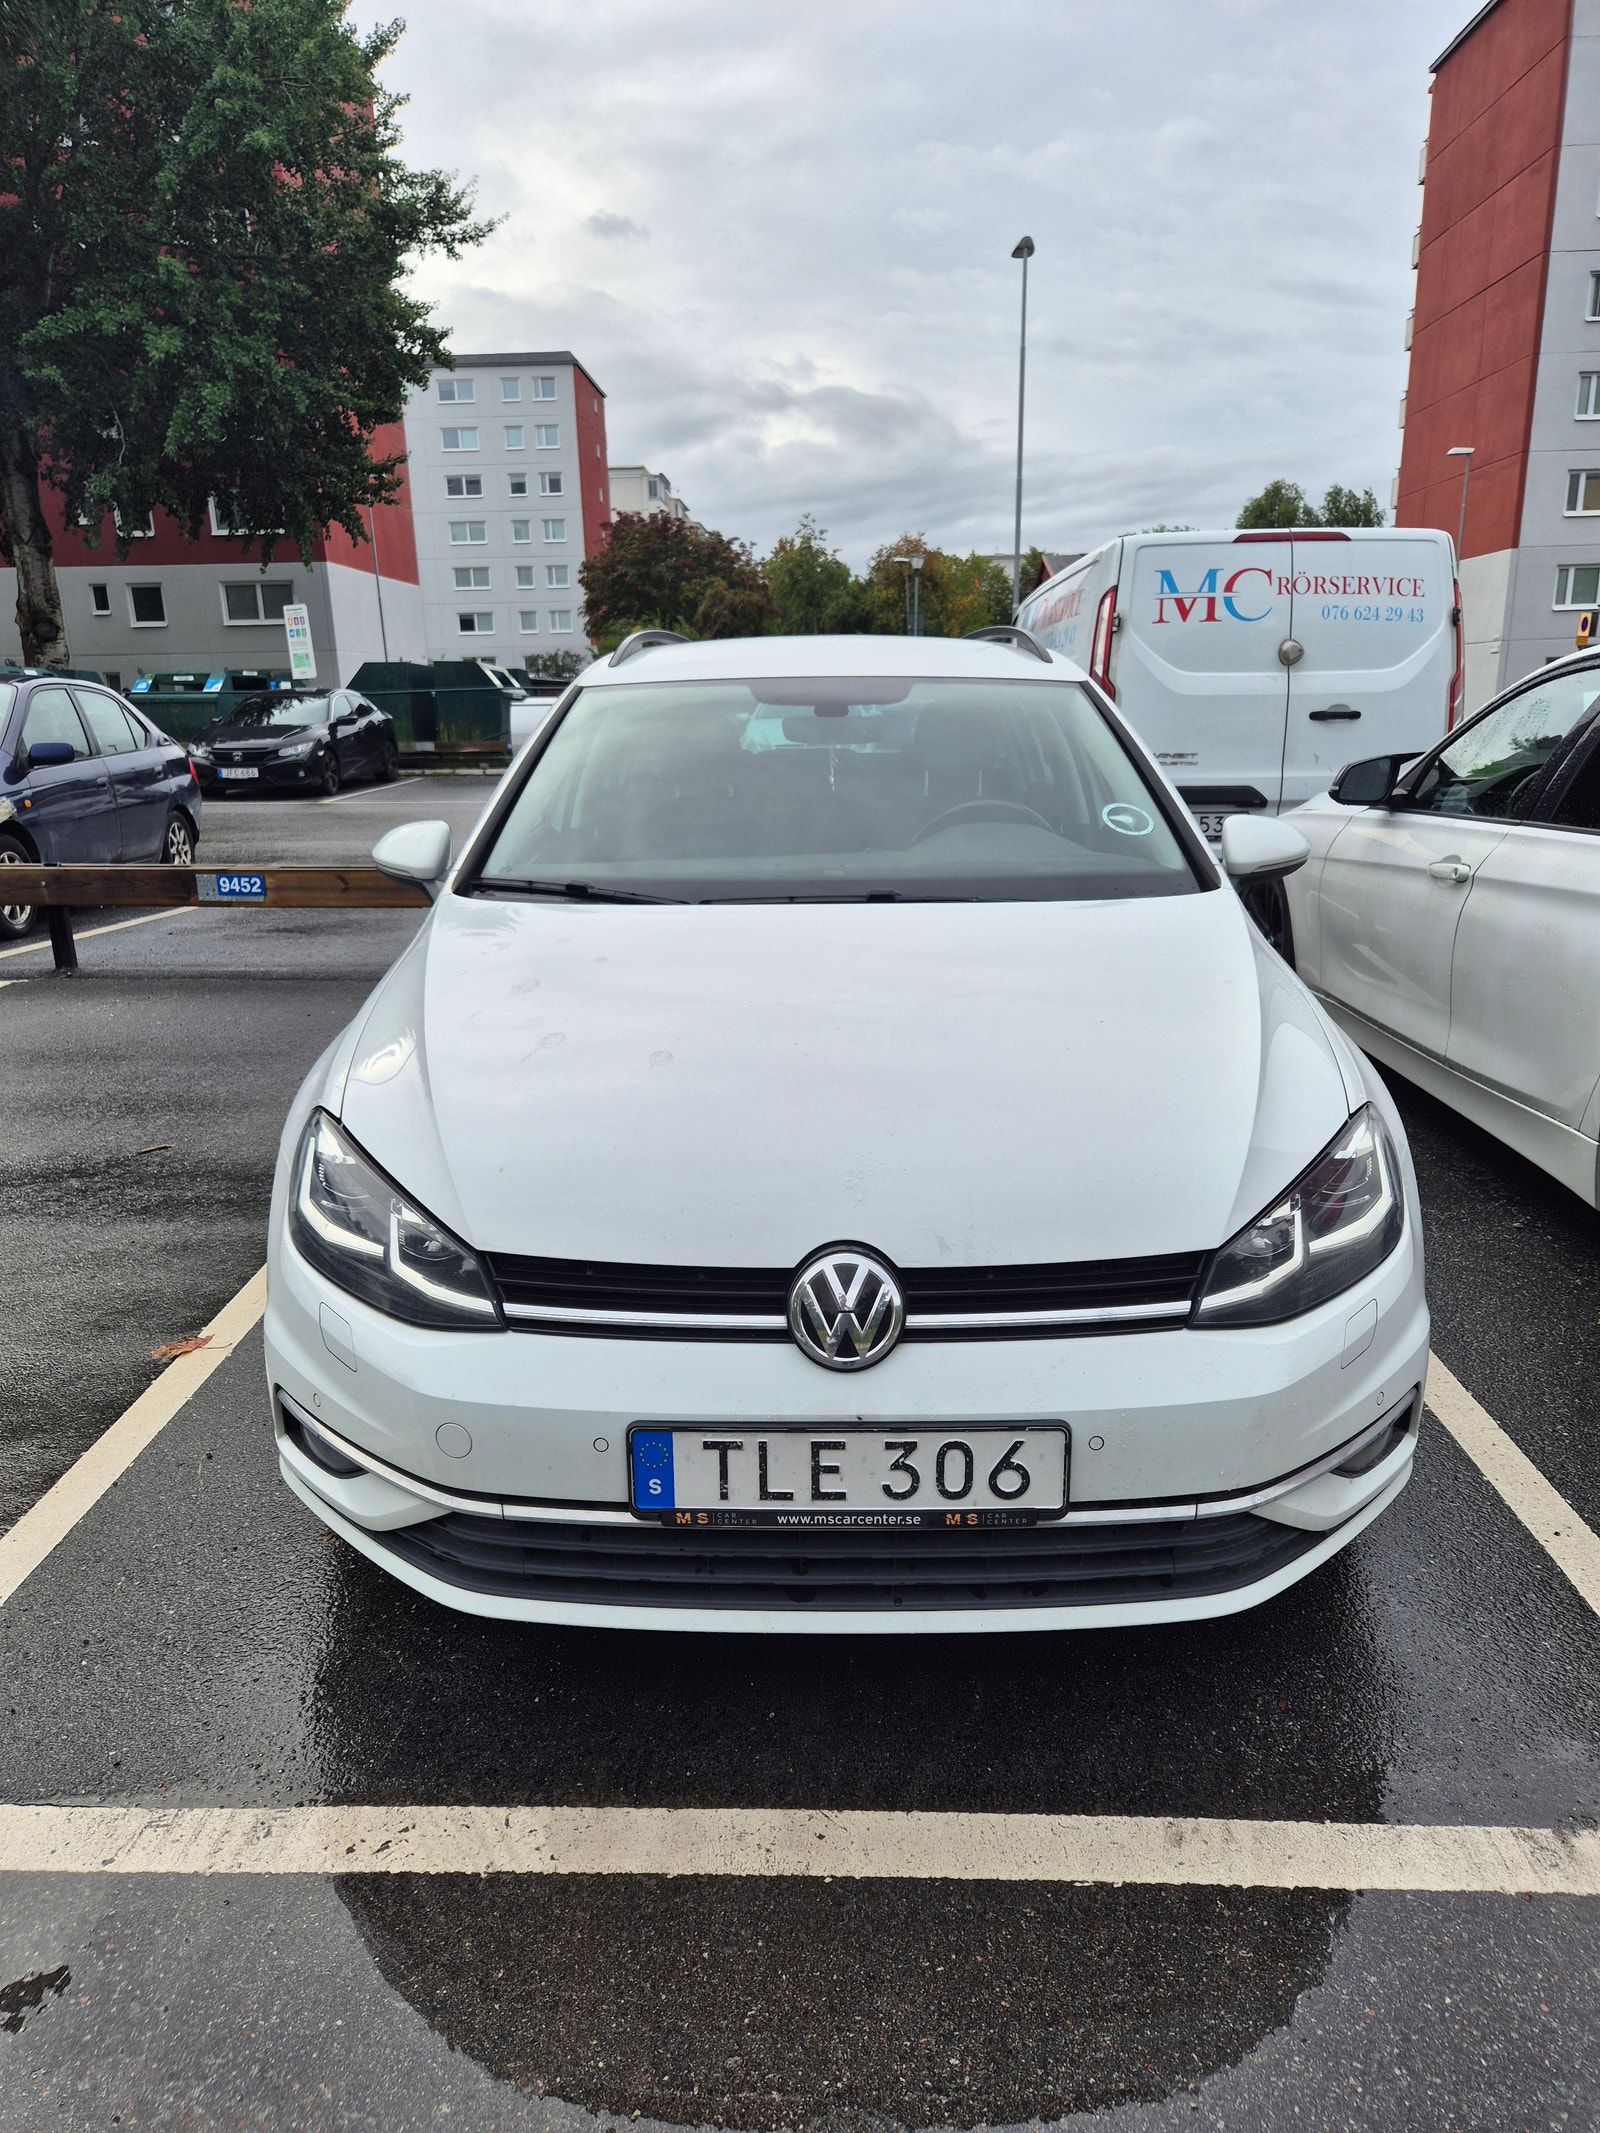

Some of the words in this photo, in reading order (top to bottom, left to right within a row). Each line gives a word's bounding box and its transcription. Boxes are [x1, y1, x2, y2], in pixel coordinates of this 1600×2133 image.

[1152, 568, 1273, 624] MC
[1276, 571, 1426, 598] RÖRSERVICE
[1321, 605, 1349, 620] 076
[1354, 605, 1381, 621] 624
[1385, 606, 1403, 622] 29
[1407, 607, 1424, 623] 43
[219, 876, 262, 893] 9452
[791, 1253, 901, 1366] VW
[702, 1440, 847, 1501] TLE
[881, 1440, 1032, 1501] 306
[649, 1478, 662, 1495] S
[777, 1514, 921, 1525] www.mscarcenter.se
